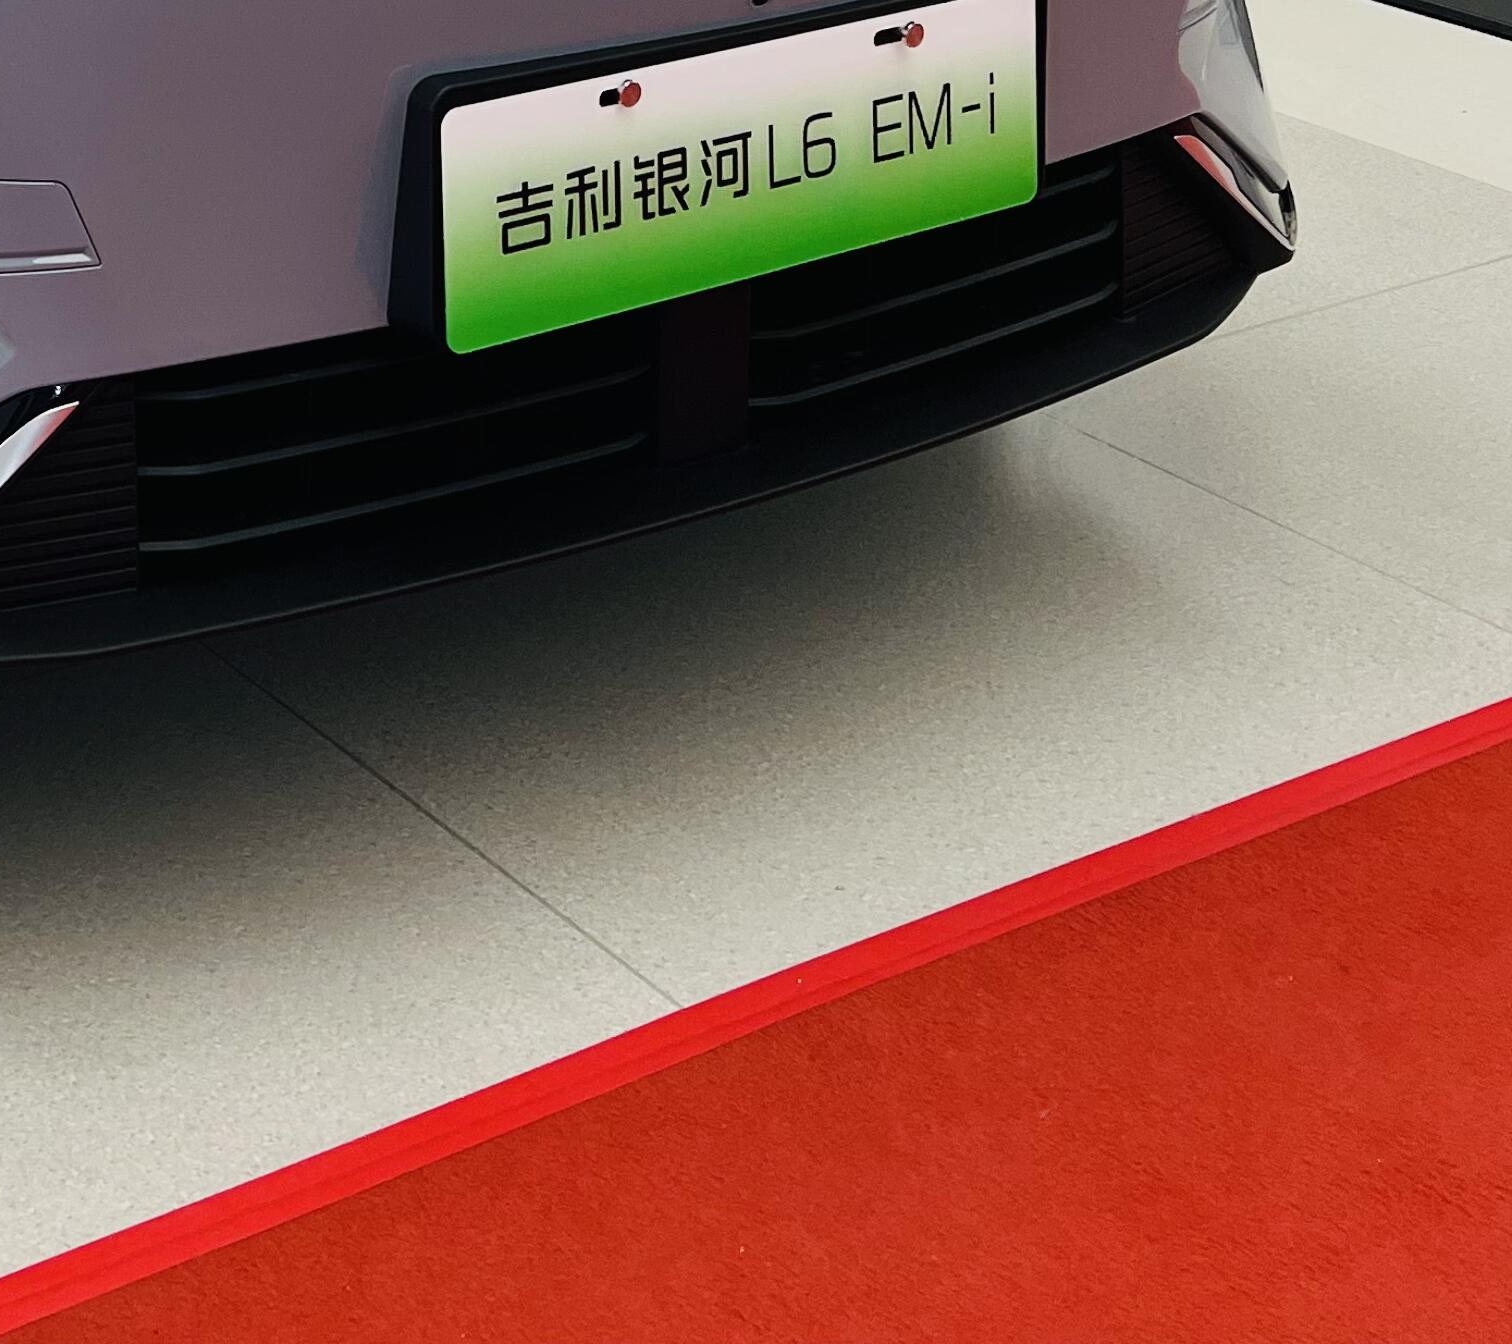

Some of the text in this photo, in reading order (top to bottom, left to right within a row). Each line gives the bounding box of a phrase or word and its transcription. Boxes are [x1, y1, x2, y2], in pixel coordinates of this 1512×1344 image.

[495, 71, 997, 256] 吉利银河L6 EM-i
